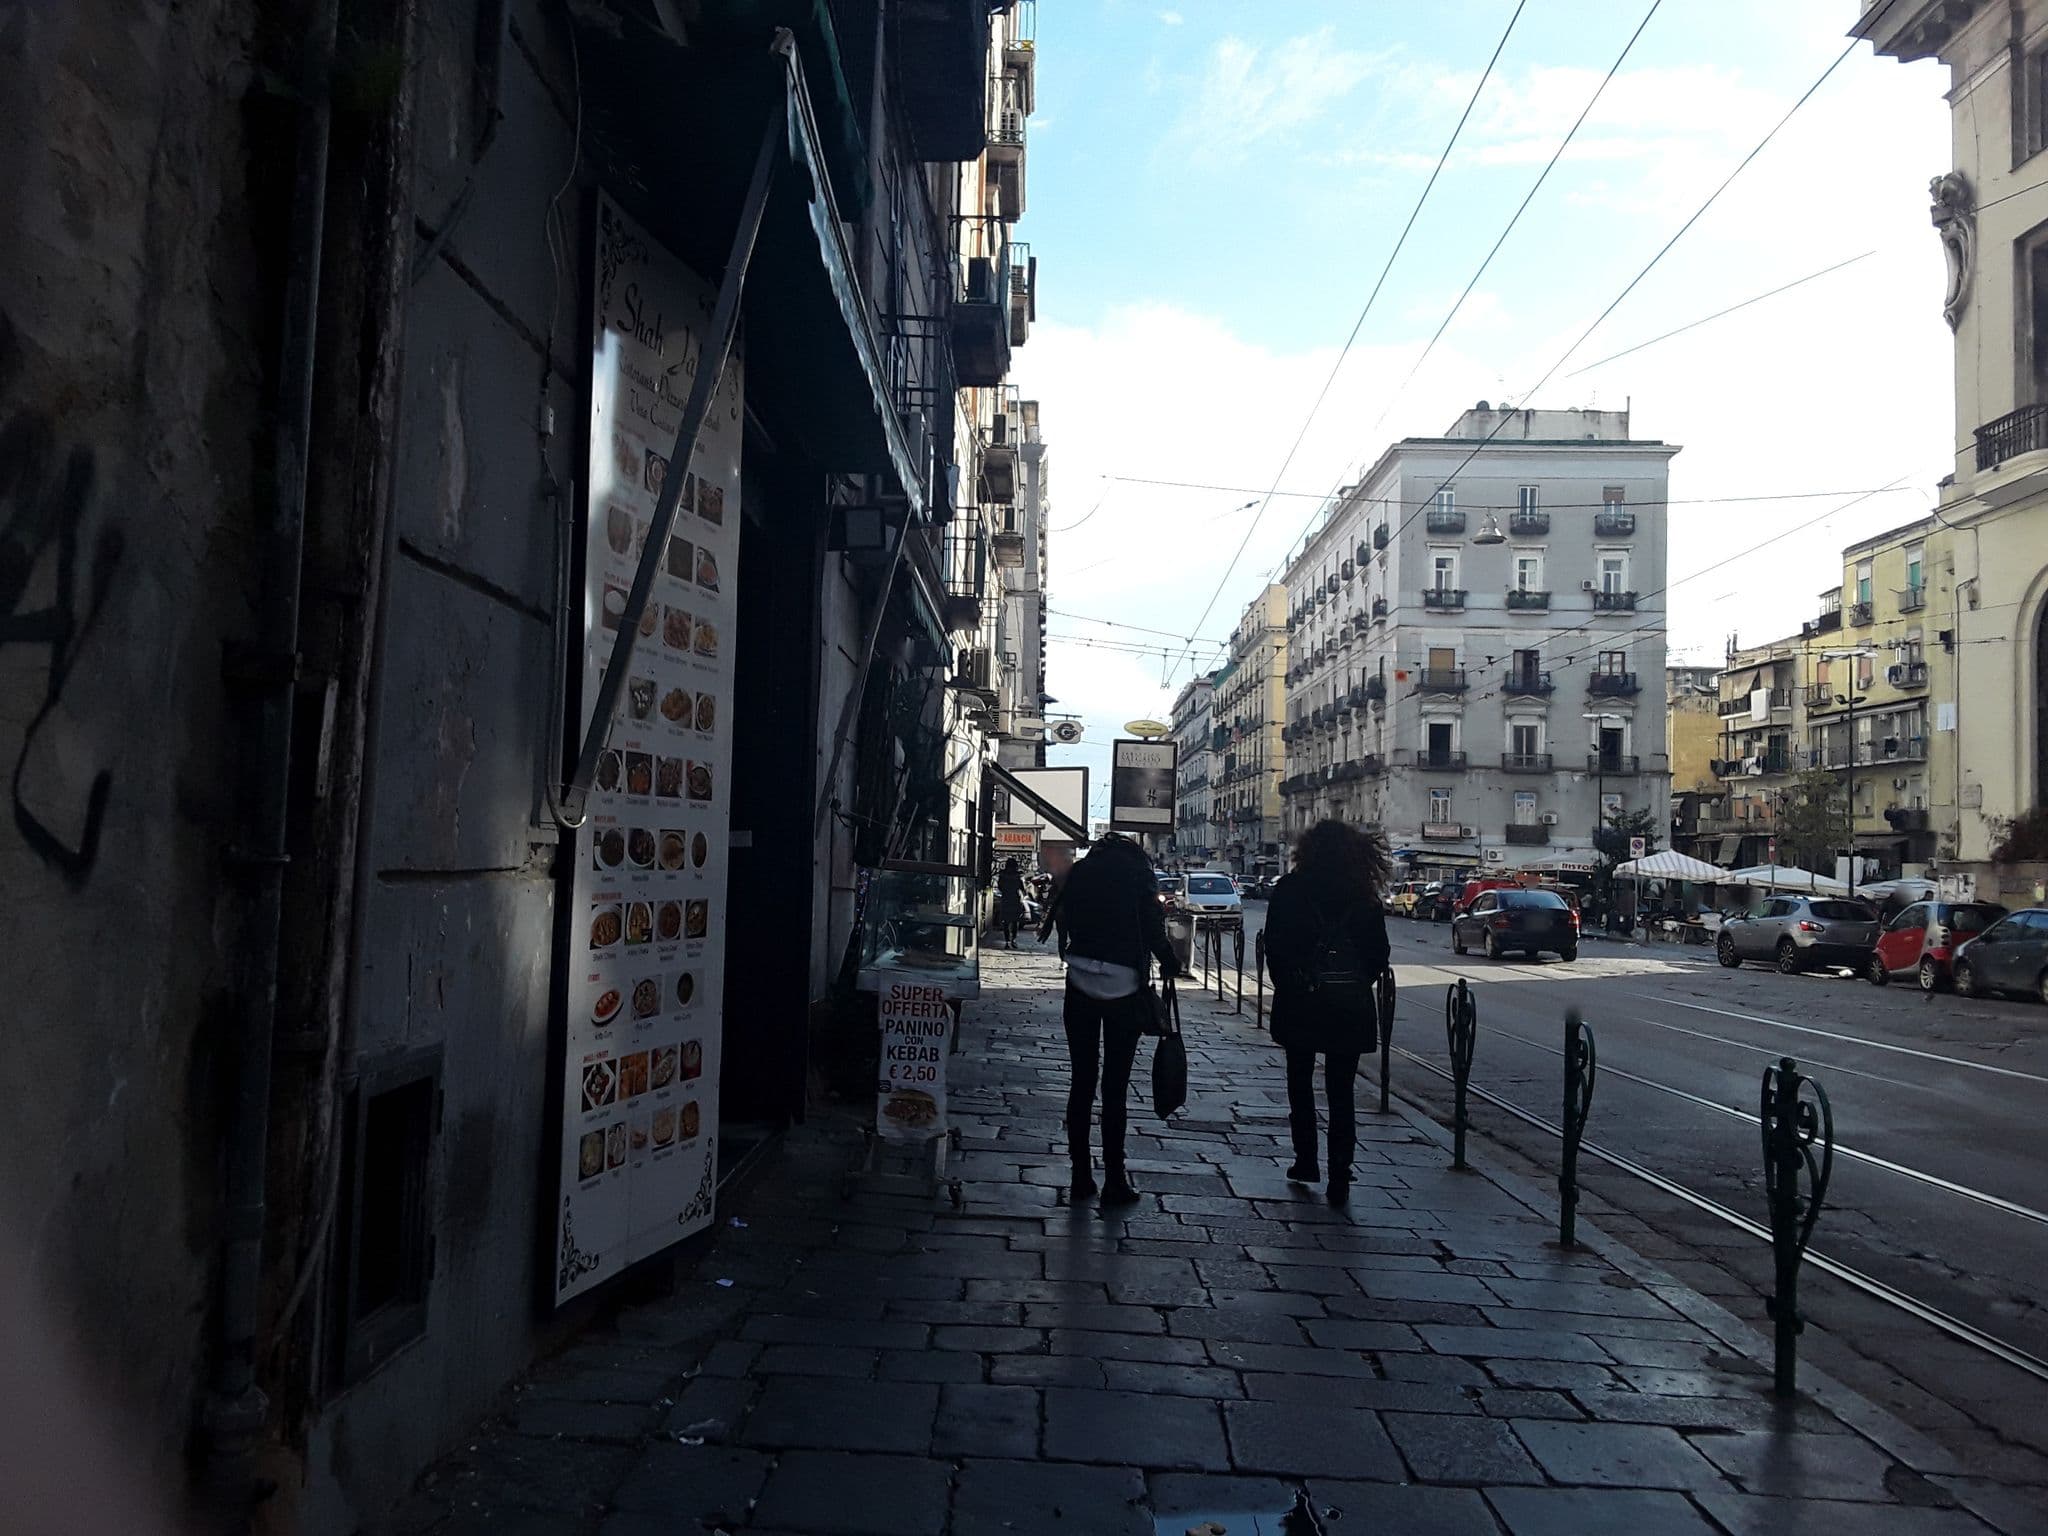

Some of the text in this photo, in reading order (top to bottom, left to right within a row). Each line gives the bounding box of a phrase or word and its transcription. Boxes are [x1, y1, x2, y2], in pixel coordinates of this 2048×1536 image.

[616, 282, 664, 357] Shah
[890, 985, 944, 1002] SUPER
[881, 1000, 949, 1019] OFFERTA
[885, 1019, 945, 1037] PANINO
[904, 1035, 924, 1045] CON
[886, 1045, 940, 1062] KEBAB
[889, 1064, 937, 1083] € 2,50
